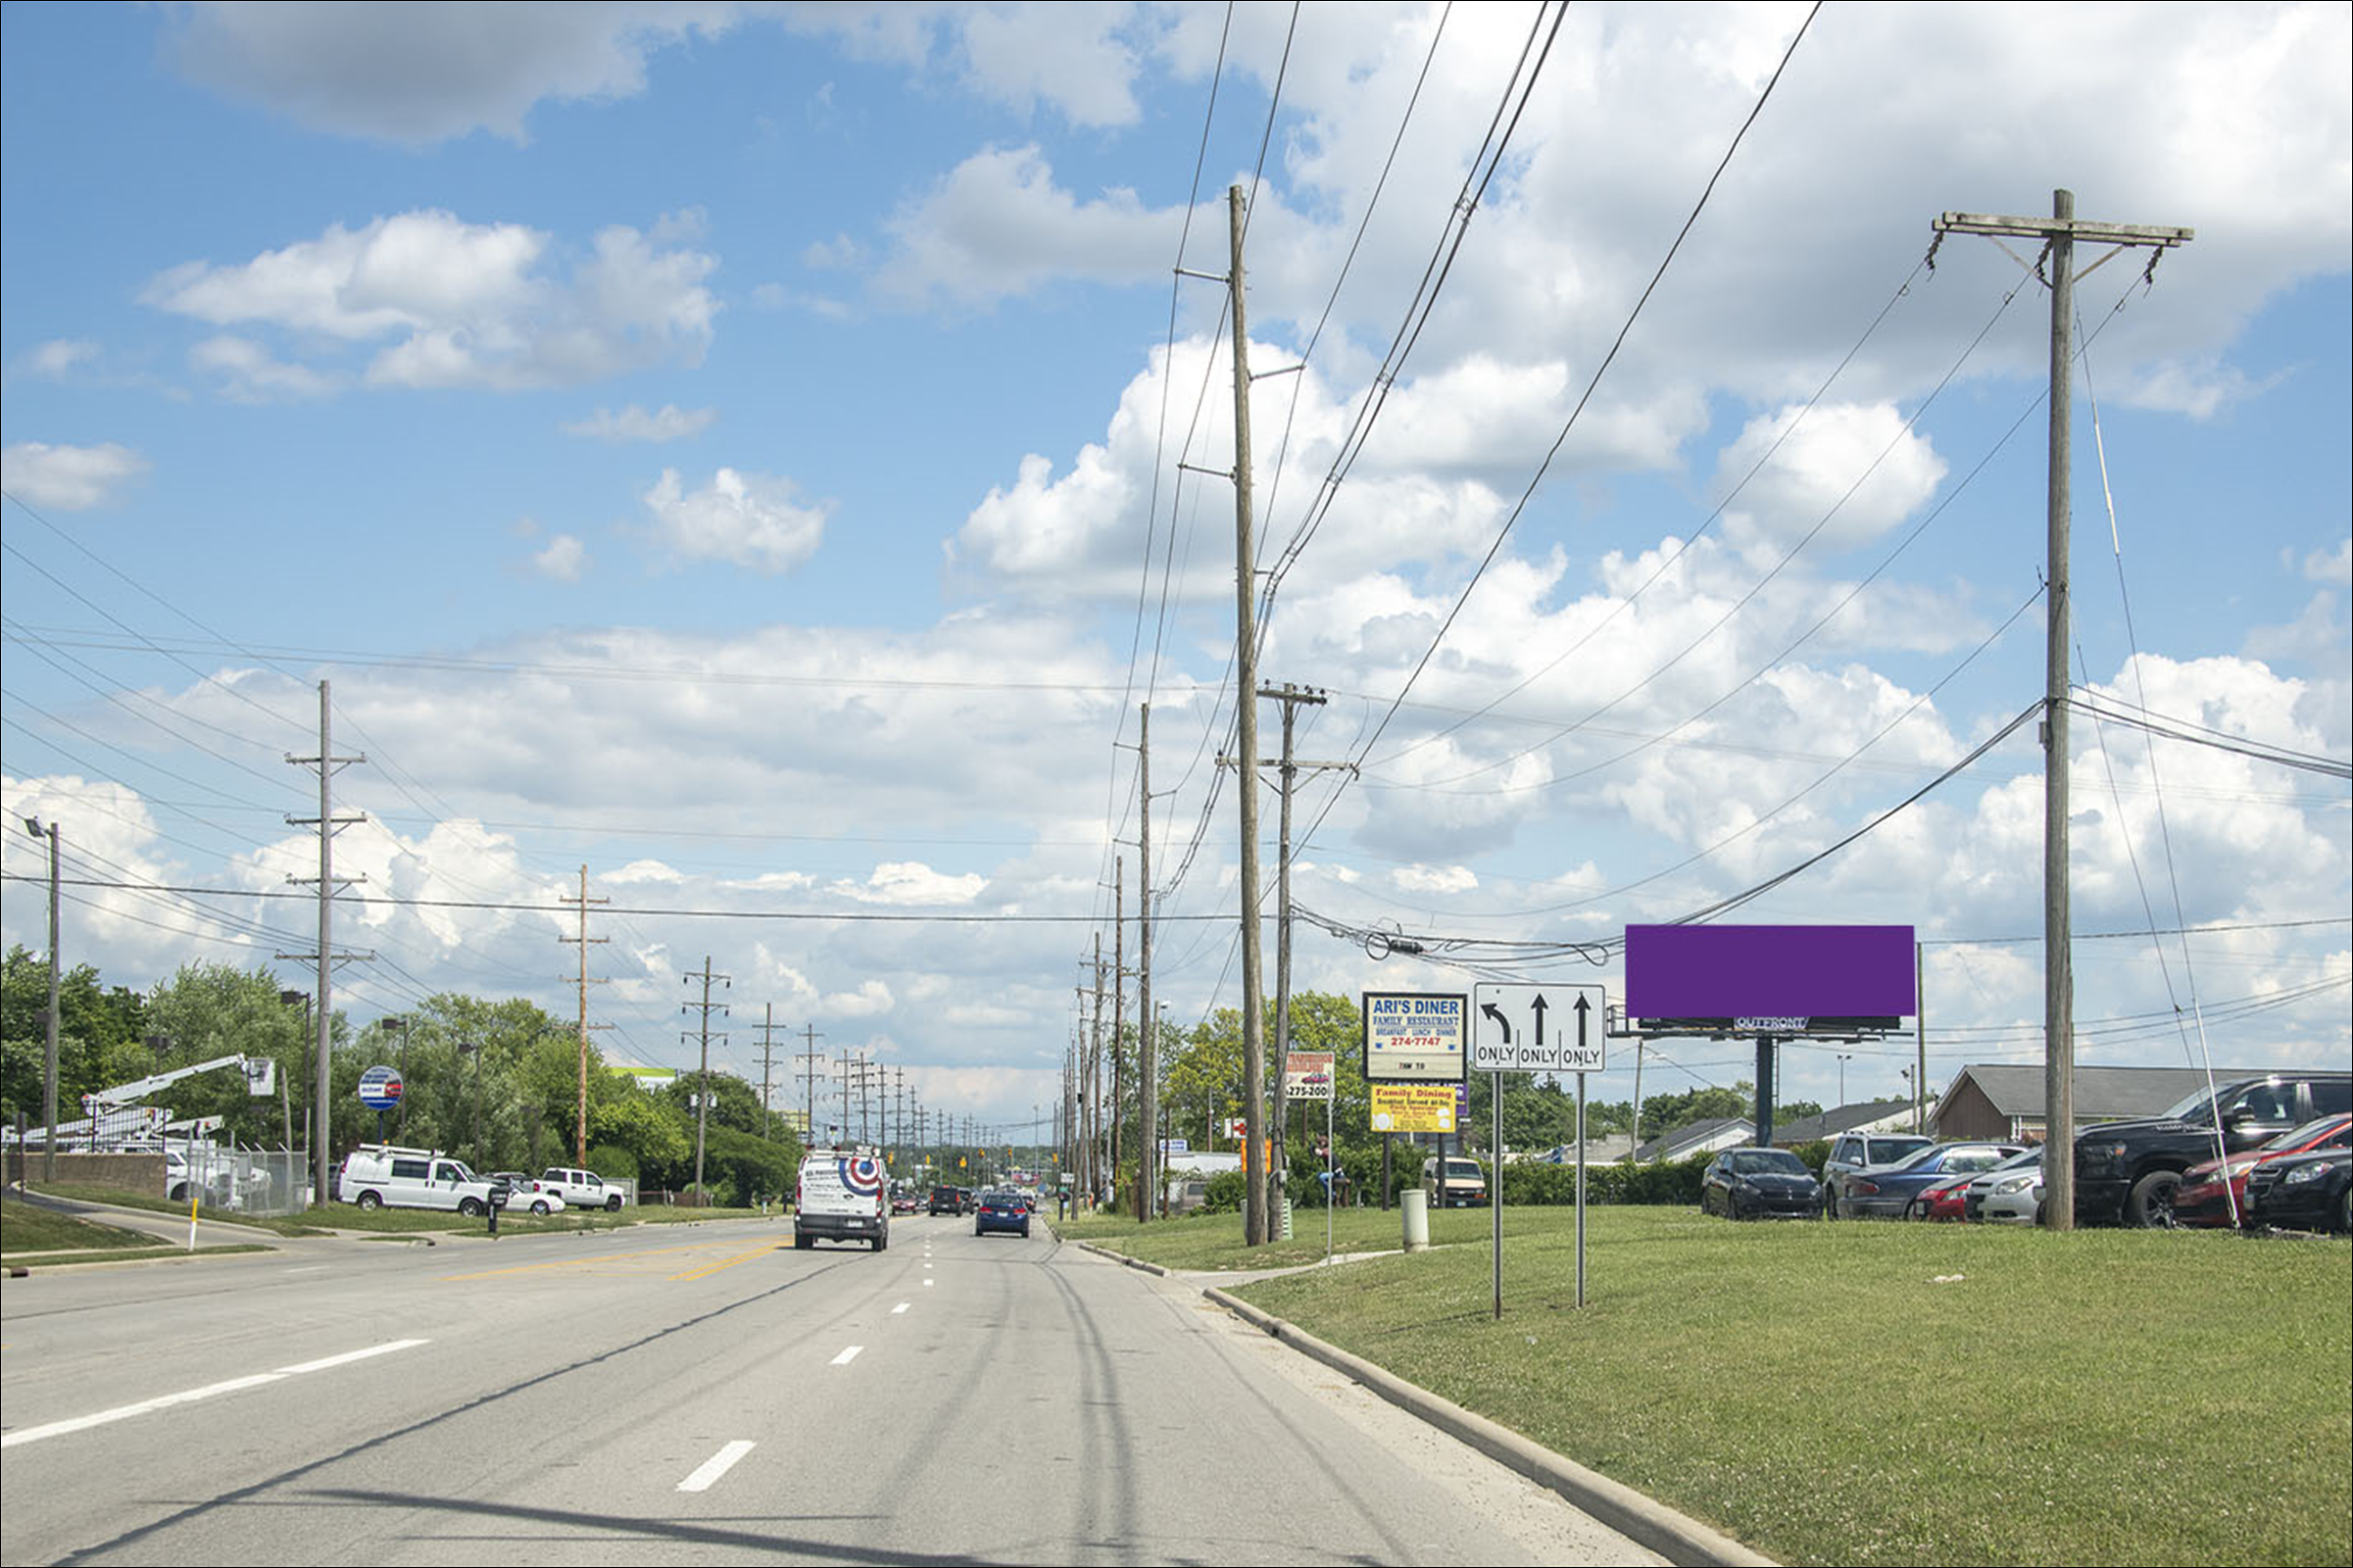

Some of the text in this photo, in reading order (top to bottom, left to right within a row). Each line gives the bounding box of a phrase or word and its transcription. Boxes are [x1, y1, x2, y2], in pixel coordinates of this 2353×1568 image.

[1373, 1000, 1459, 1015] ARI'S DINER
[1373, 1016, 1459, 1026] FAMILY RESTAURANT
[1478, 1046, 1515, 1060] ONLY
[1520, 1048, 1557, 1062] ONLY
[1563, 1050, 1599, 1063] ONLY
[1376, 1089, 1452, 1100] Family Dining
